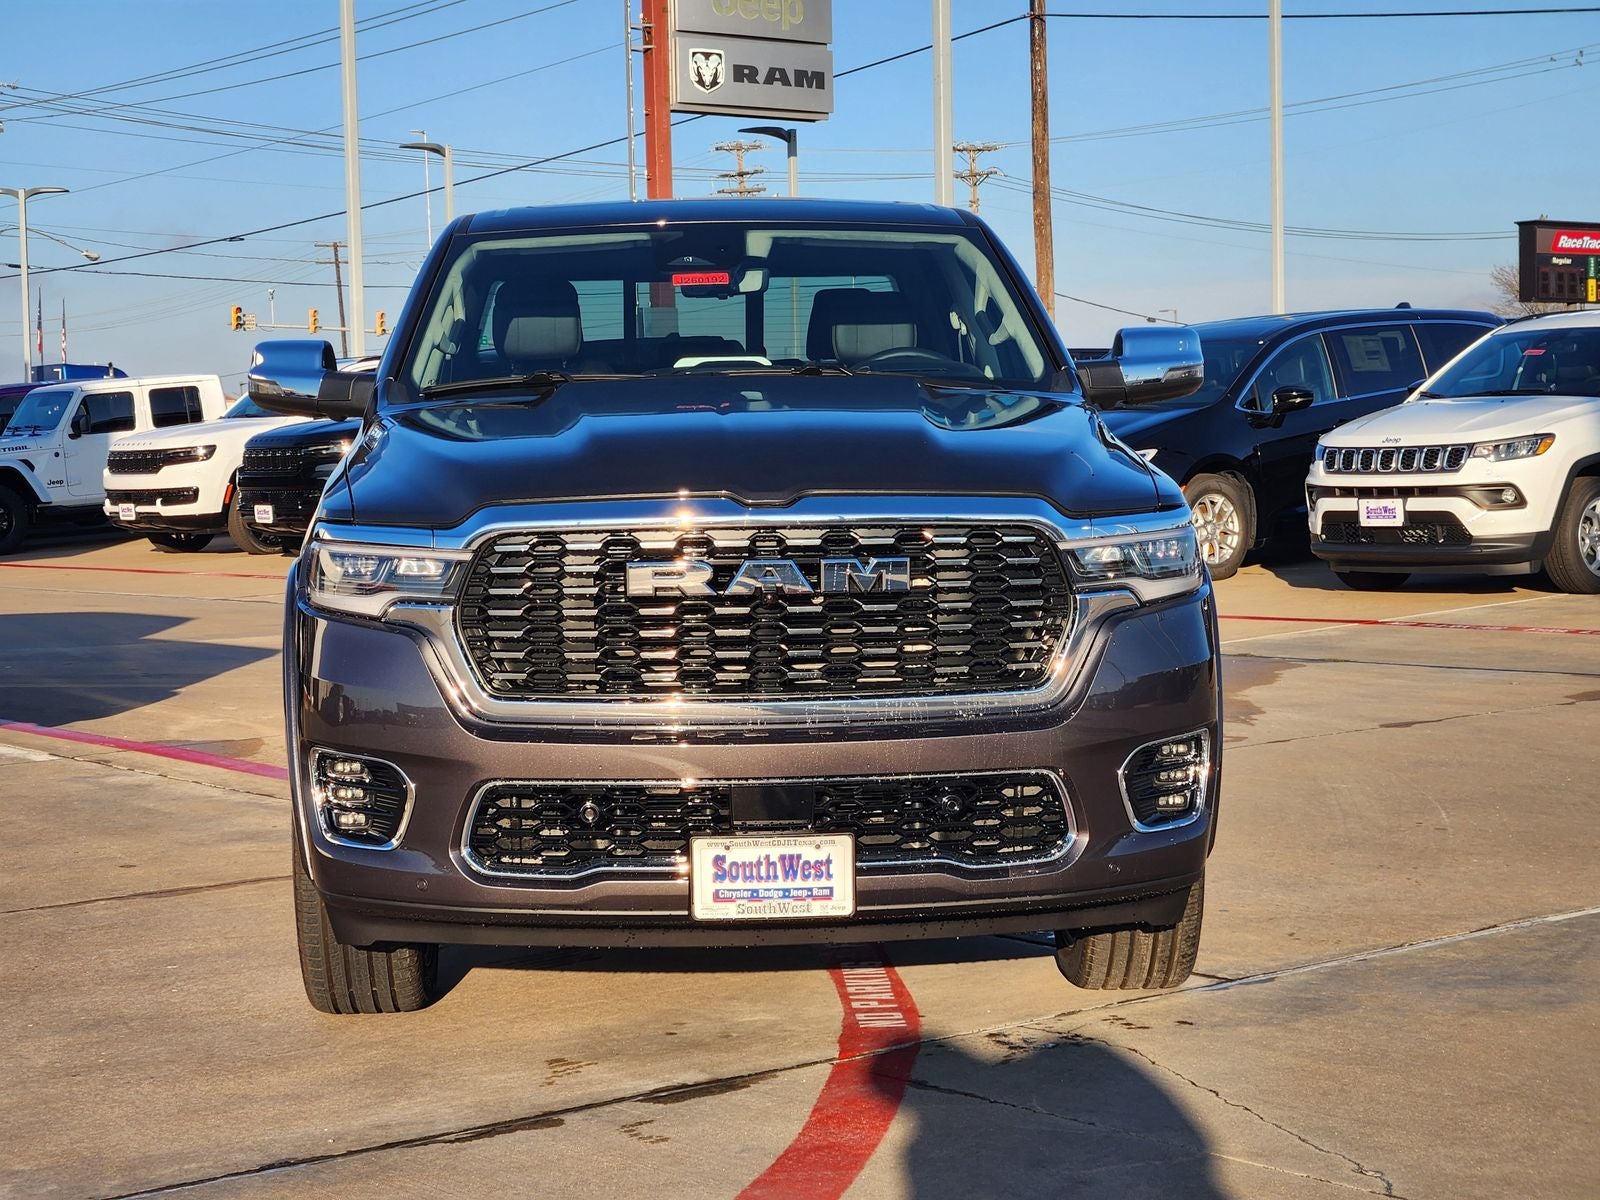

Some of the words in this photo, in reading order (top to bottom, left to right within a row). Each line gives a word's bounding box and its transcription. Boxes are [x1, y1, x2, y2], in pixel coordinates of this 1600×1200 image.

[732, 64, 825, 90] RAM
[1558, 235, 1600, 249] RaceTrac
[626, 557, 911, 597] RAM
[712, 852, 833, 883] SouthWest
[718, 888, 752, 899] Chrysler
[758, 888, 783, 898] Dodge
[788, 887, 808, 898] Jeep
[812, 886, 830, 897] Ram
[737, 902, 813, 915] SouthWest
[855, 1011, 908, 1028] NO
